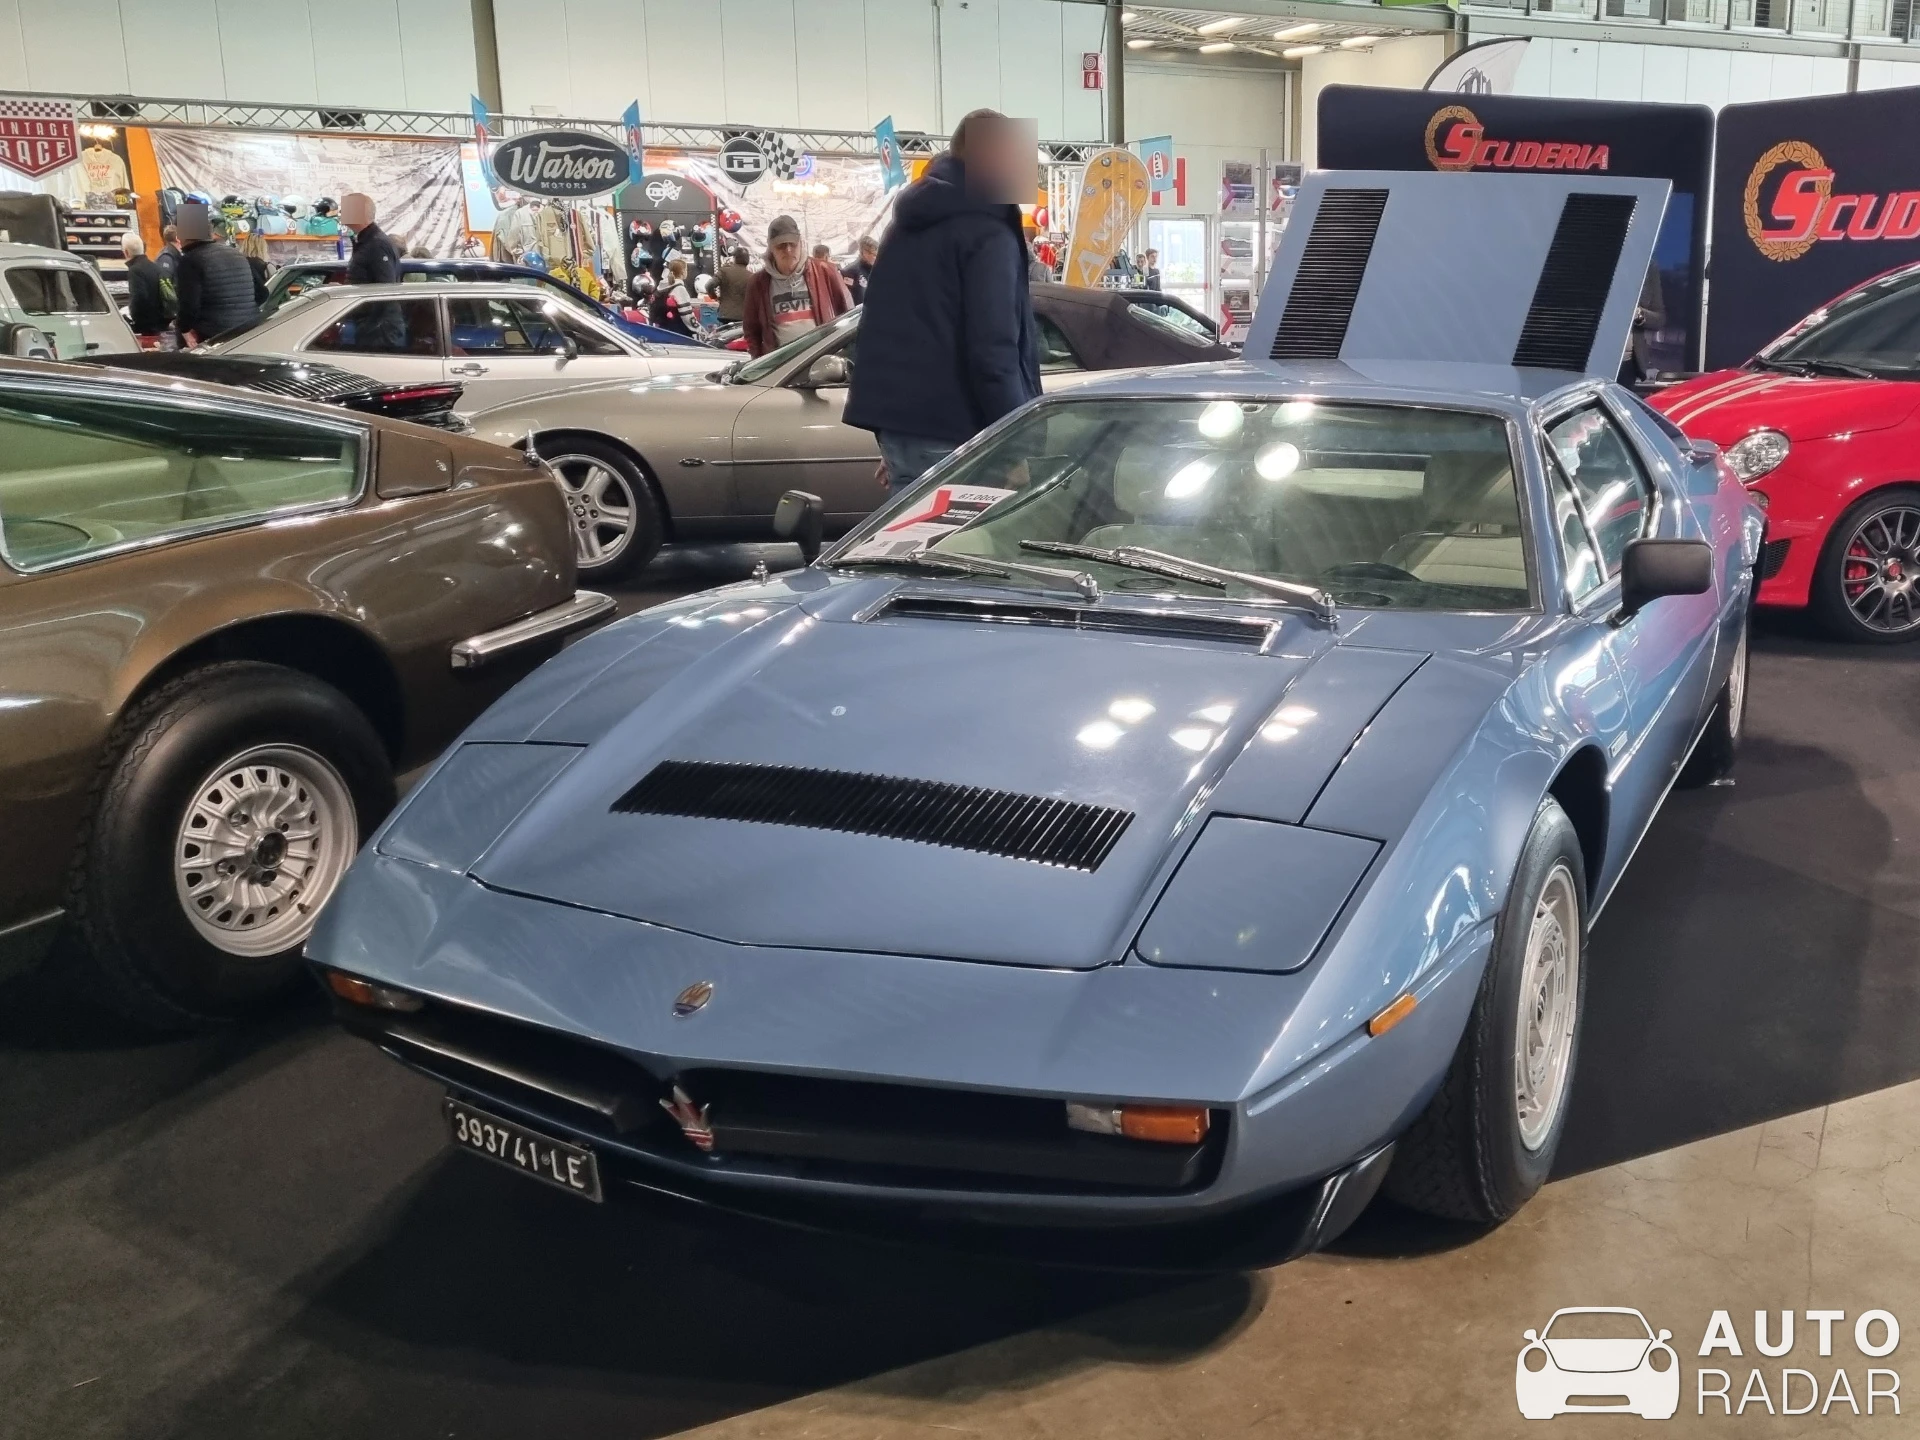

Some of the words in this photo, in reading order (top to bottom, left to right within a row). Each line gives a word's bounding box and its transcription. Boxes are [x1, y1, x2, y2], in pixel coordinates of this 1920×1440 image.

[0, 140, 66, 166] RACE
[1437, 123, 1608, 169] SCUDERIA
[507, 140, 616, 183] Warson
[1154, 152, 1162, 179] Gulf
[541, 181, 587, 189] MOTORS
